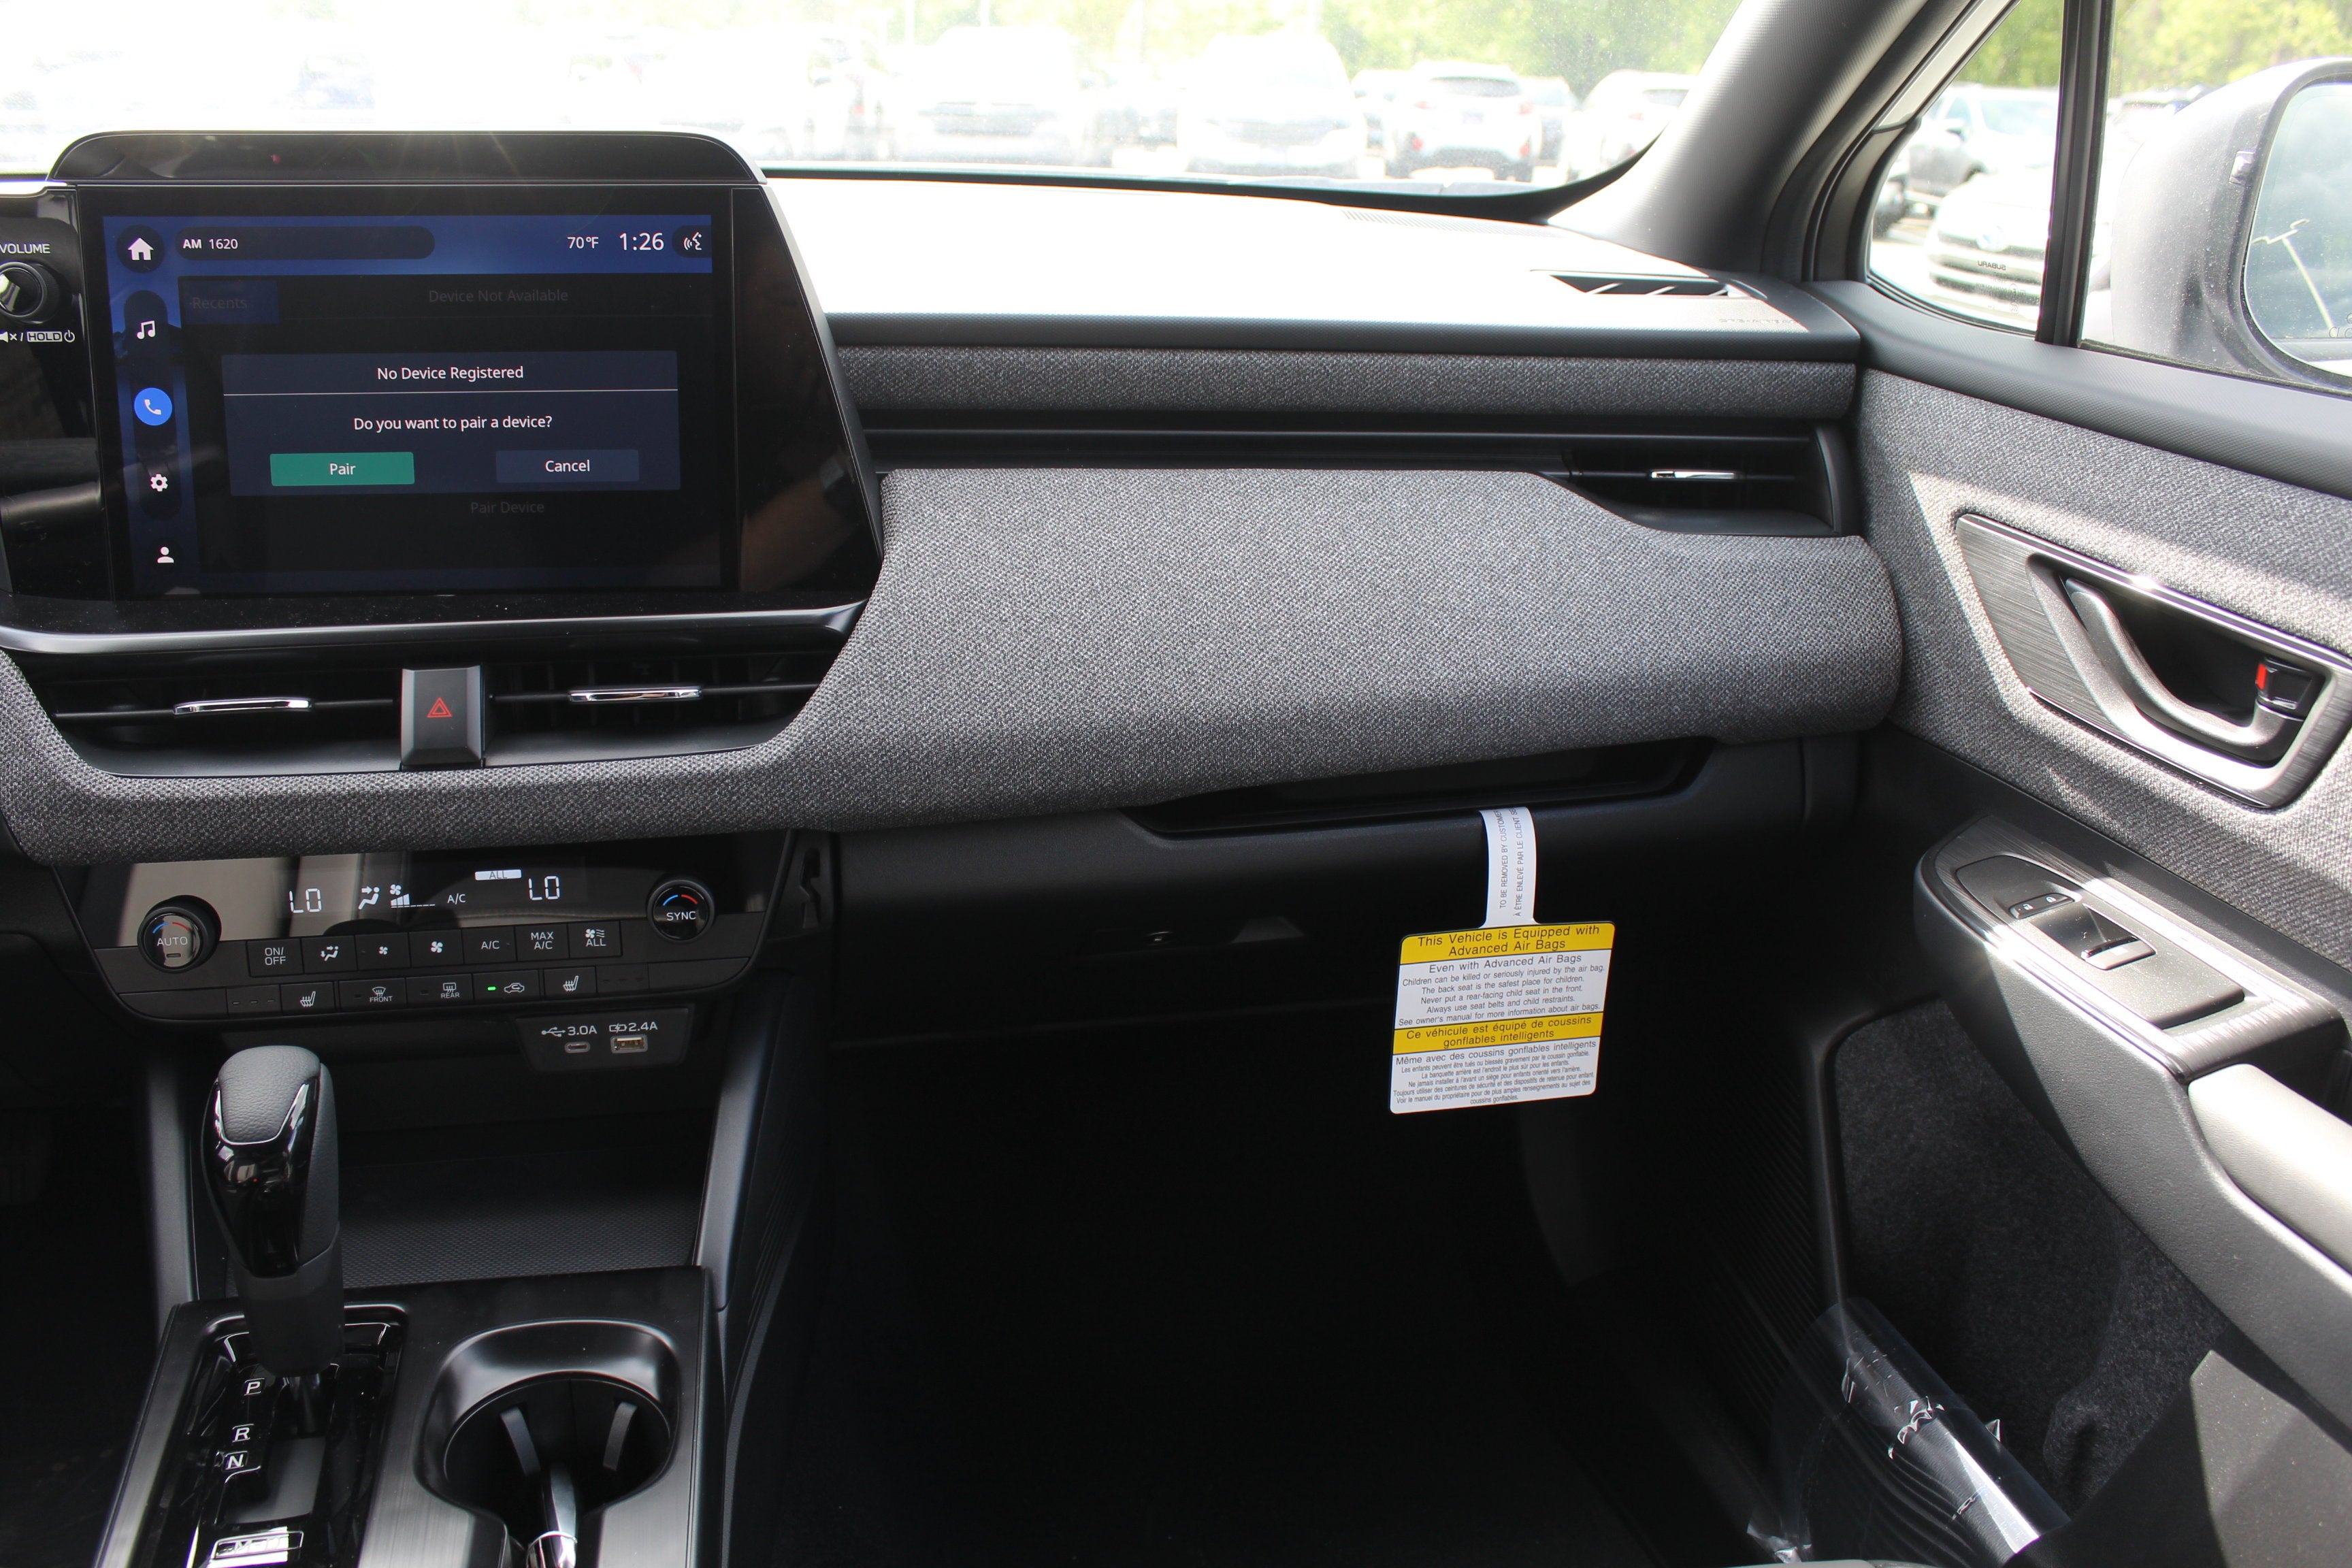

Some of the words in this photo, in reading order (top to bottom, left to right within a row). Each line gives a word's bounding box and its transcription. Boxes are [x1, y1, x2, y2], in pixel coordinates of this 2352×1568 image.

[183, 240, 201, 248] AM
[209, 239, 238, 249] 1620
[568, 237, 598, 248] 70°F
[620, 233, 664, 250] 1:26
[0, 243, 50, 253] VOLUME
[429, 291, 473, 302] Device
[478, 290, 502, 301] Not
[507, 289, 568, 301] Available
[192, 297, 247, 309] Recents
[29, 332, 61, 341] HOLD
[378, 368, 397, 379] No
[402, 368, 446, 379] Device
[451, 366, 523, 382] Registered
[355, 419, 372, 429] Do
[376, 421, 401, 433] you
[405, 419, 439, 429] want
[442, 419, 457, 428] to
[461, 416, 487, 431] pair
[491, 419, 498, 427] a
[503, 416, 552, 427] device?
[330, 463, 355, 474] Pair
[546, 460, 589, 472] Cancel
[471, 502, 496, 513] Pair
[501, 502, 544, 513] Device
[1513, 817, 1522, 838] CLIENT
[1518, 841, 1523, 849] LE
[489, 870, 508, 879] ALL
[448, 894, 466, 904] A/C
[1501, 889, 1507, 898] BE
[1500, 900, 1506, 909] TO
[666, 911, 696, 921] SYNC
[157, 936, 187, 946] AUTO
[531, 932, 554, 941] MAX
[1418, 936, 1443, 947] This
[1449, 931, 1492, 944] Vehicle
[1498, 930, 1507, 939] is
[1514, 926, 1570, 941] Equipped
[1576, 925, 1599, 935] with
[481, 941, 500, 949] A/C
[534, 941, 553, 949] A/C
[586, 938, 606, 947] ALL
[1448, 943, 1508, 956] Advanced
[1514, 941, 1531, 953] Air
[1536, 940, 1565, 951] Bags
[264, 947, 284, 956] ON/
[264, 956, 286, 965] OFF
[1429, 964, 1454, 973] Even
[1459, 961, 1479, 970] with
[1484, 956, 1534, 968] Advanced
[1538, 956, 1552, 964] Air
[1556, 954, 1582, 964] Bags
[1402, 977, 1432, 987] Children
[1463, 973, 1481, 981] killed
[1493, 969, 1524, 979] seriously
[1527, 967, 1550, 977] injured
[1553, 966, 1562, 975] by
[1590, 964, 1604, 973] bag.
[1438, 985, 1455, 993] back
[1458, 983, 1473, 992] seat
[1498, 979, 1519, 988] safest
[1522, 979, 1541, 987] place
[1555, 975, 1584, 983] children.
[1421, 996, 1442, 1004] Never
[1444, 995, 1456, 1003] put
[1466, 991, 1503, 1000] rear-facing
[1506, 989, 1522, 997] child
[1470, 1002, 1485, 1010] seat
[1488, 1000, 1504, 1009] belts
[1507, 998, 1520, 1007] and
[1523, 997, 1539, 1005] child
[1542, 995, 1575, 1004] restraints.
[1399, 1018, 1413, 1026] See
[1416, 1016, 1443, 1024] owner's
[1446, 1013, 1472, 1022] manual
[1507, 1007, 1546, 1016] information
[567, 1025, 598, 1036] 3.0A
[627, 1022, 658, 1032] 2.4A
[1407, 1030, 1421, 1039] Ce
[1426, 1026, 1468, 1037] véhicule
[1473, 1024, 1488, 1034] est
[1492, 1020, 1526, 1032] équipé
[1531, 1019, 1544, 1028] de
[1548, 1016, 1591, 1027] coussins
[1443, 1034, 1495, 1049] gonflables
[1501, 1030, 1554, 1041] intelligents
[1396, 1056, 1422, 1065] Même
[1449, 1052, 1465, 1060] des
[1468, 1049, 1505, 1059] coussins
[1508, 1045, 1550, 1057] gonflables
[1554, 1041, 1597, 1051] intelligents
[246, 1382, 261, 1394] P
[234, 1427, 250, 1440] R
[227, 1455, 244, 1468] N
